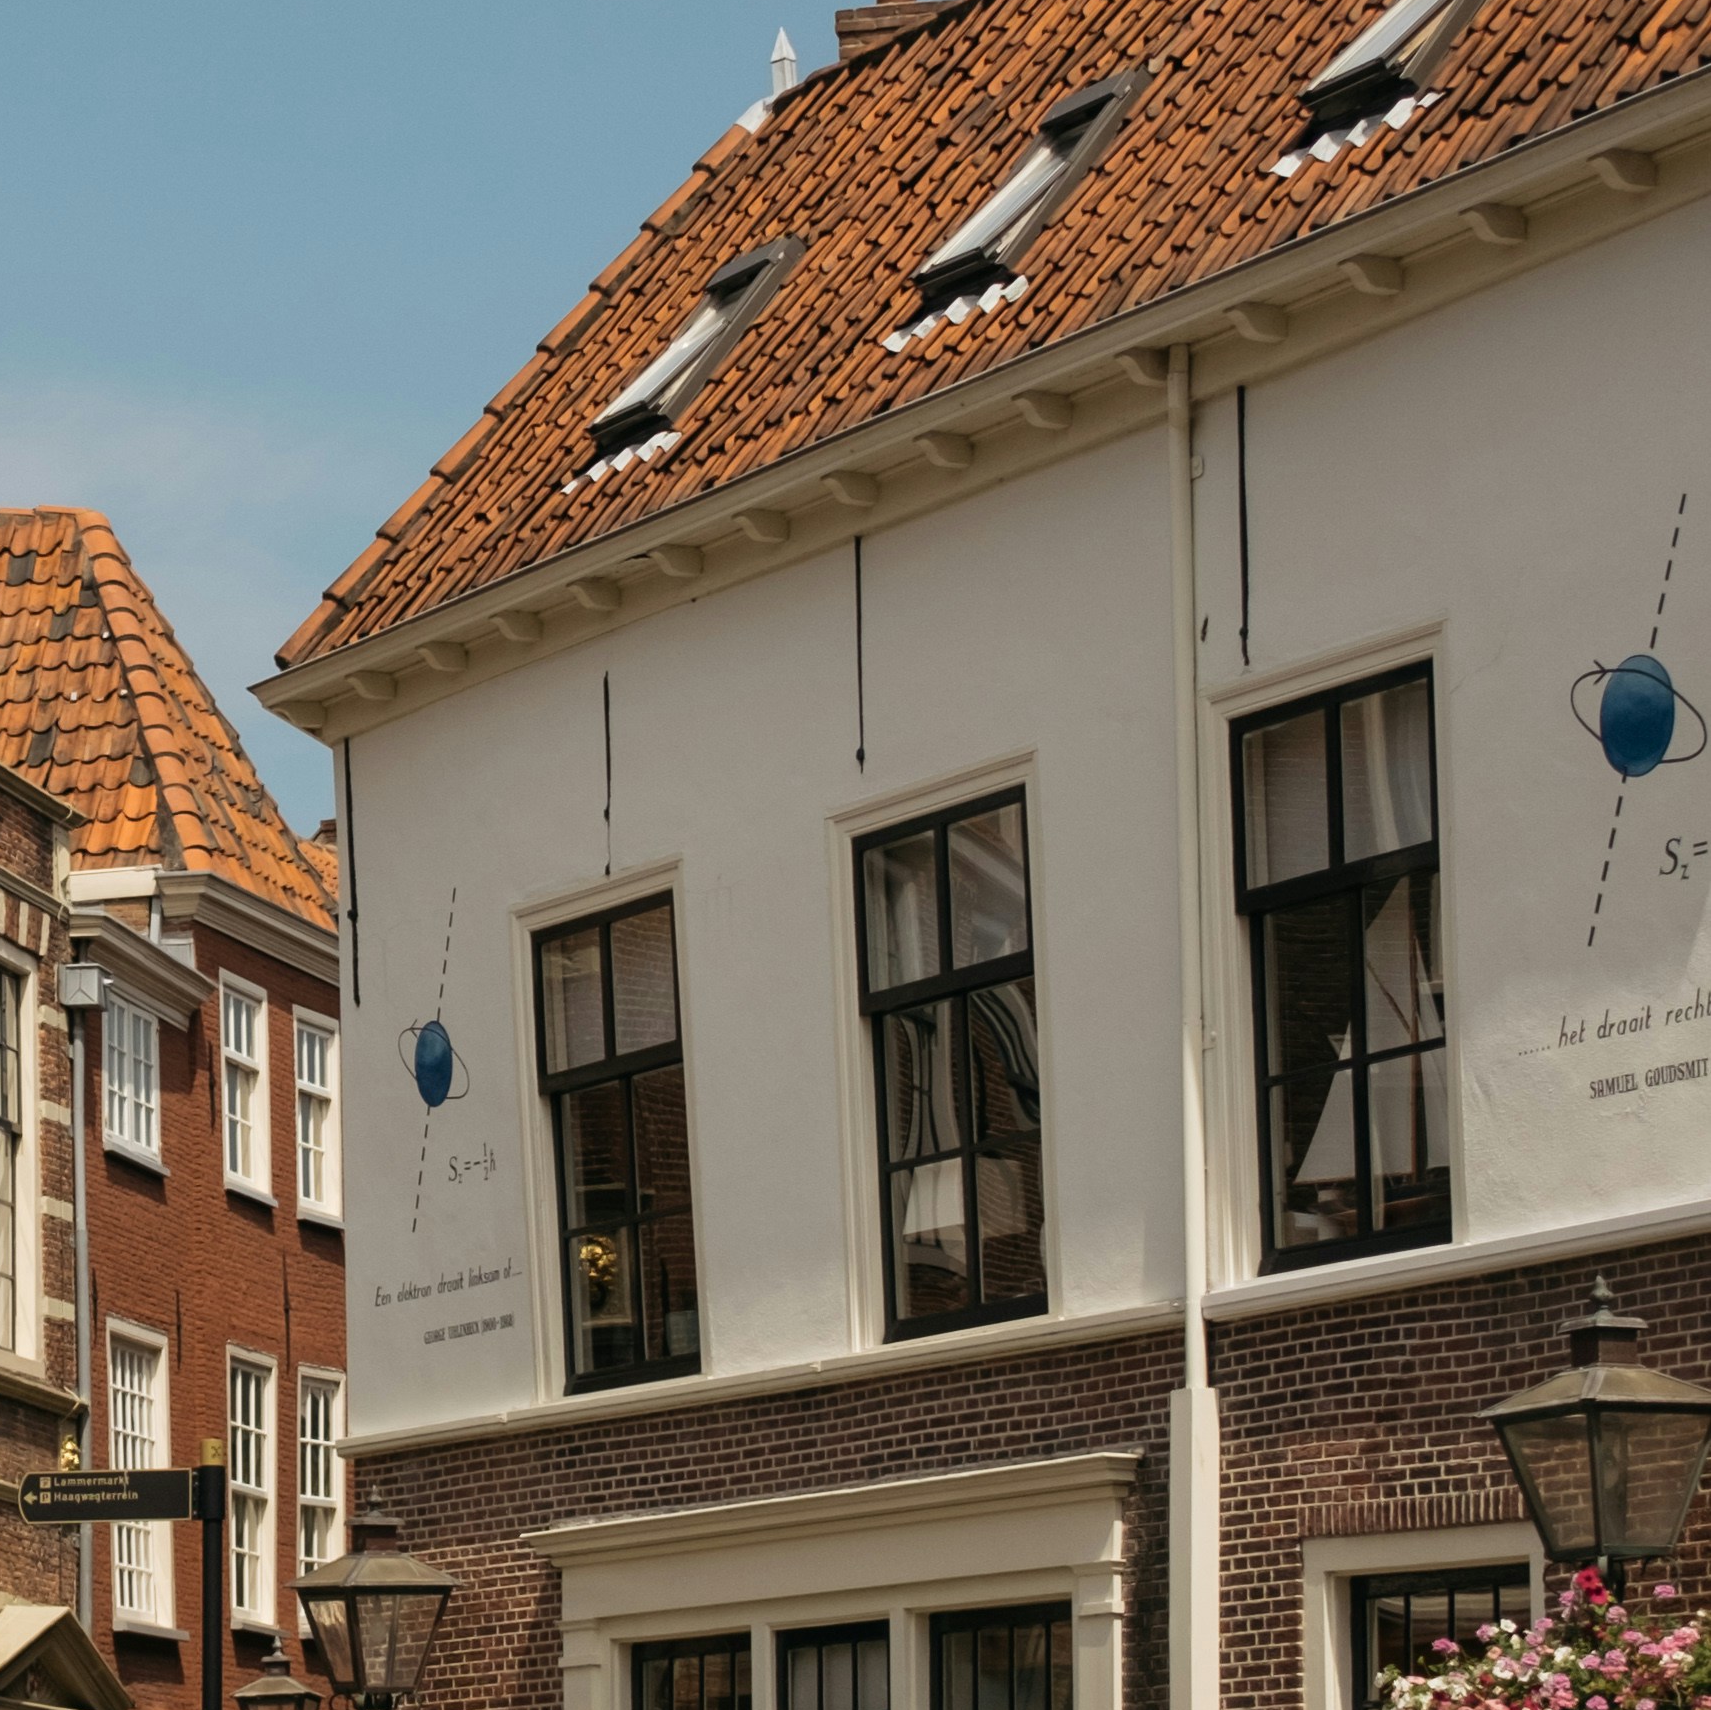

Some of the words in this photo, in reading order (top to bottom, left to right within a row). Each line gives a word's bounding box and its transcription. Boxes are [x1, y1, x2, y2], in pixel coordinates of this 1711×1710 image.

[1558, 1015, 1586, 1049] het
[1597, 1004, 1652, 1040] draait
[1589, 1072, 1638, 1099] SAMUEL
[1645, 1057, 1709, 1087] GOUDSMIT
[374, 1285, 392, 1307] Een
[397, 1280, 433, 1303] elektron
[437, 1272, 464, 1294] draait
[53, 1476, 130, 1487] Lammermarkt
[53, 1490, 139, 1504] Haagwegterrein
